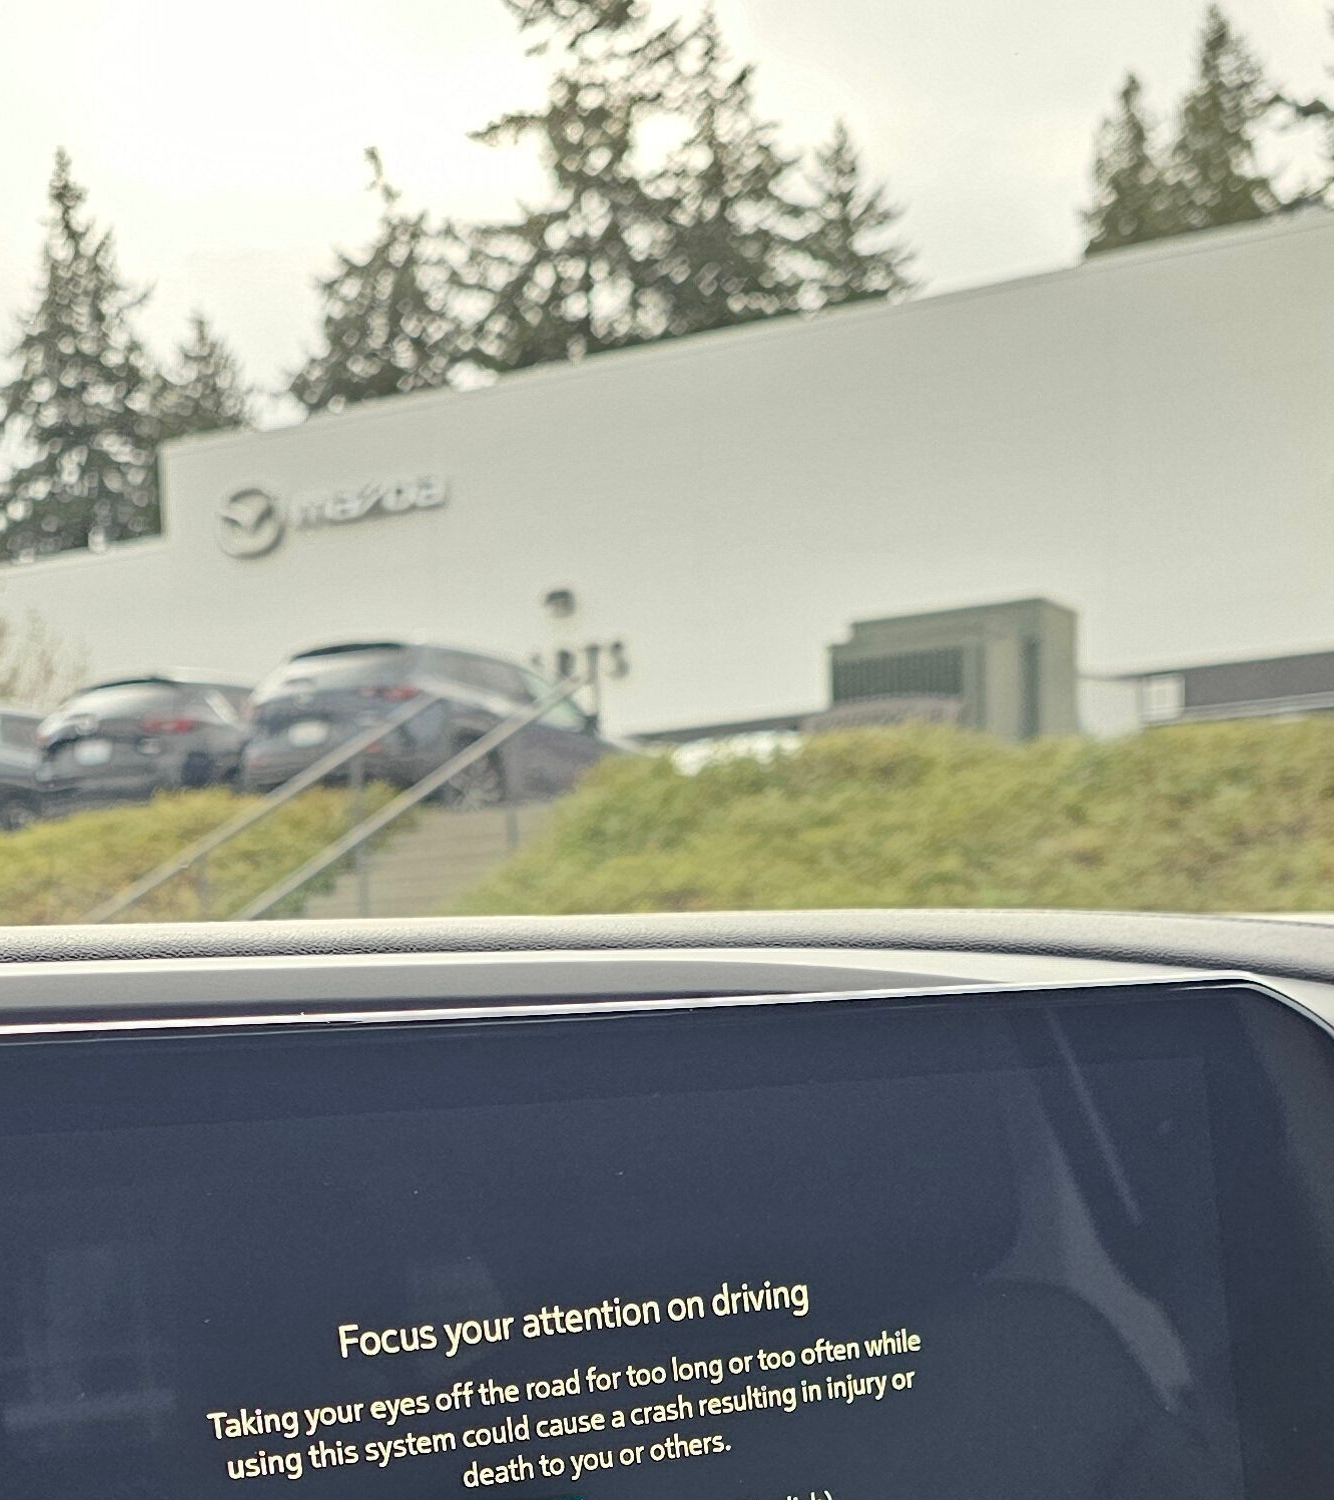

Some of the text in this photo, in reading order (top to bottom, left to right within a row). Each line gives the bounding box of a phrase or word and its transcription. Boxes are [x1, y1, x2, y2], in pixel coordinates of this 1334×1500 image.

[337, 1280, 809, 1358] Focus your attention on driving
[206, 1328, 922, 1440] Taking your eyes off the road for too long or too often while
[227, 1369, 916, 1480] using this system could cause a crash resulting in injury or
[462, 1432, 732, 1488] death to you or others.
